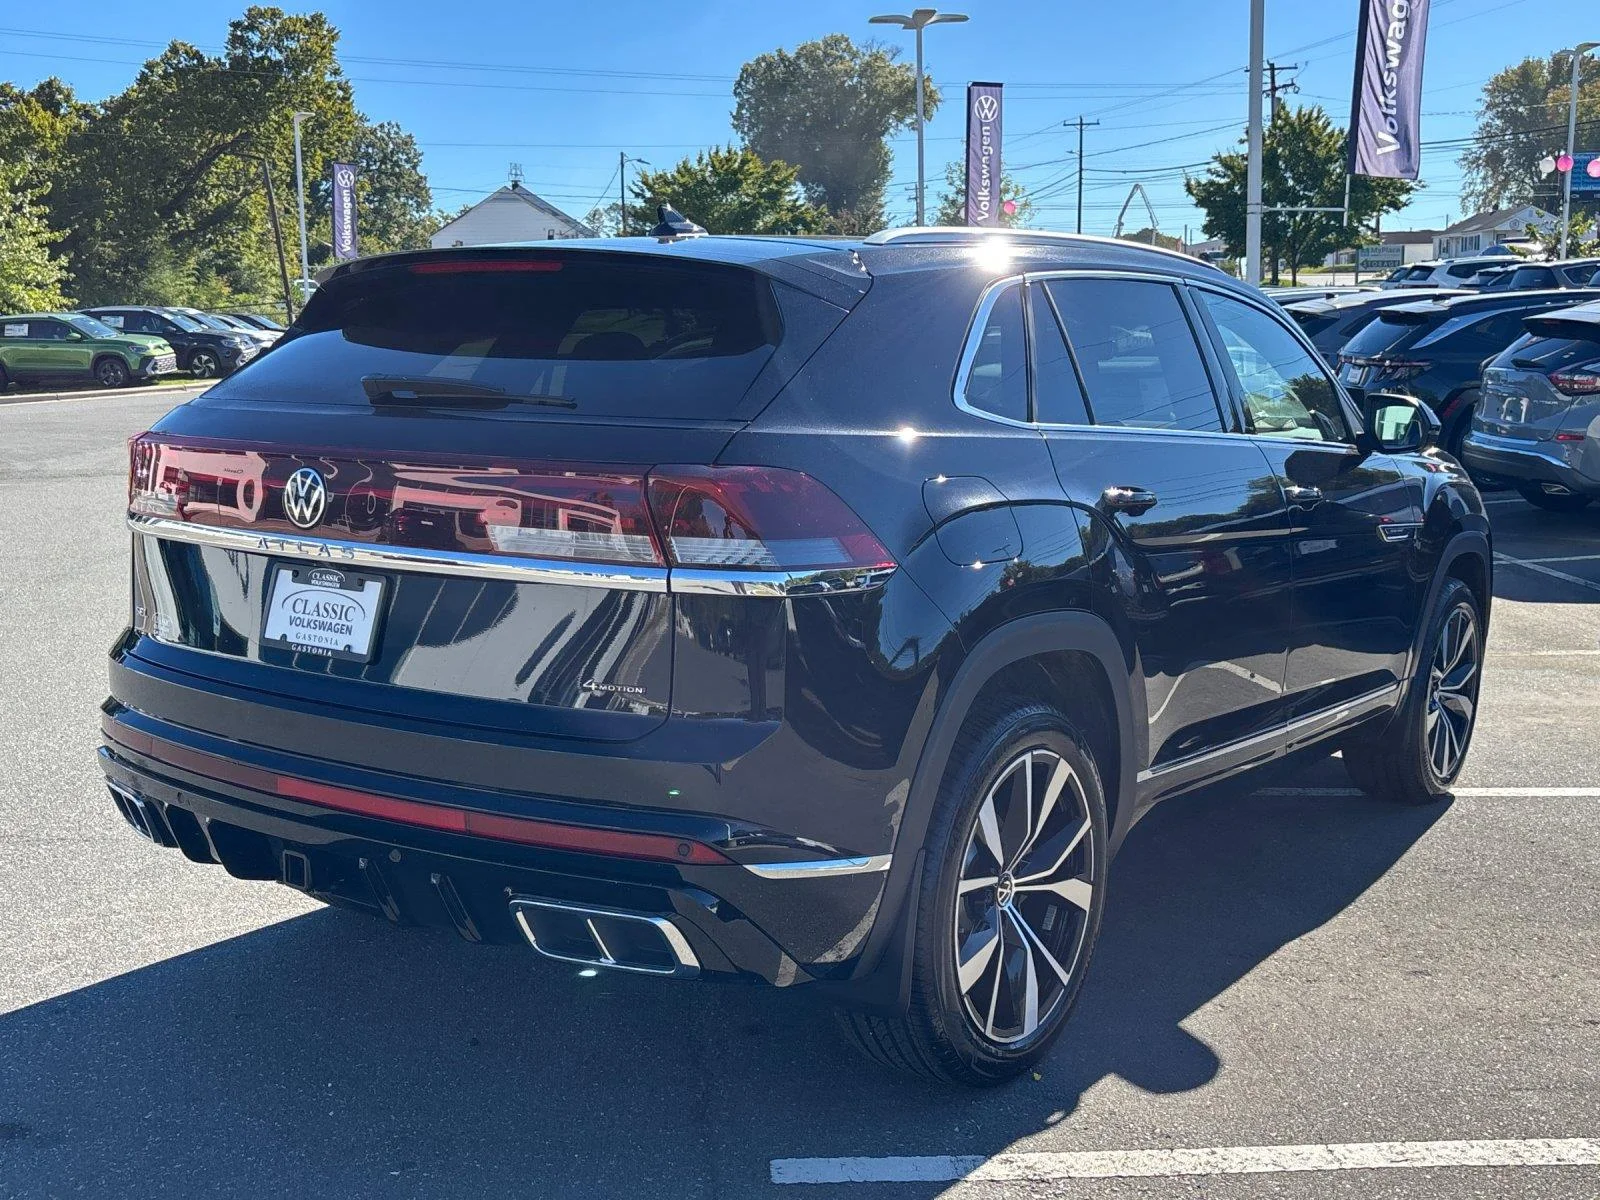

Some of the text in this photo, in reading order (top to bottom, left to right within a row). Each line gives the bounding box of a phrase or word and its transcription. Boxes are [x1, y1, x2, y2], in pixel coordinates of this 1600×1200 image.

[977, 126, 993, 221] Volkswagen
[341, 189, 352, 252] Volkswagen
[257, 537, 355, 560] ATLAS
[311, 580, 341, 588] VOLKSWAGEN
[312, 571, 342, 582] CLASSIC
[292, 597, 356, 622] CLASSIC
[289, 615, 353, 636] VOLKSWAGEN
[295, 632, 339, 647] GASTONIA
[291, 643, 332, 657] GASTONIA
[582, 679, 643, 694] 4MOTION
